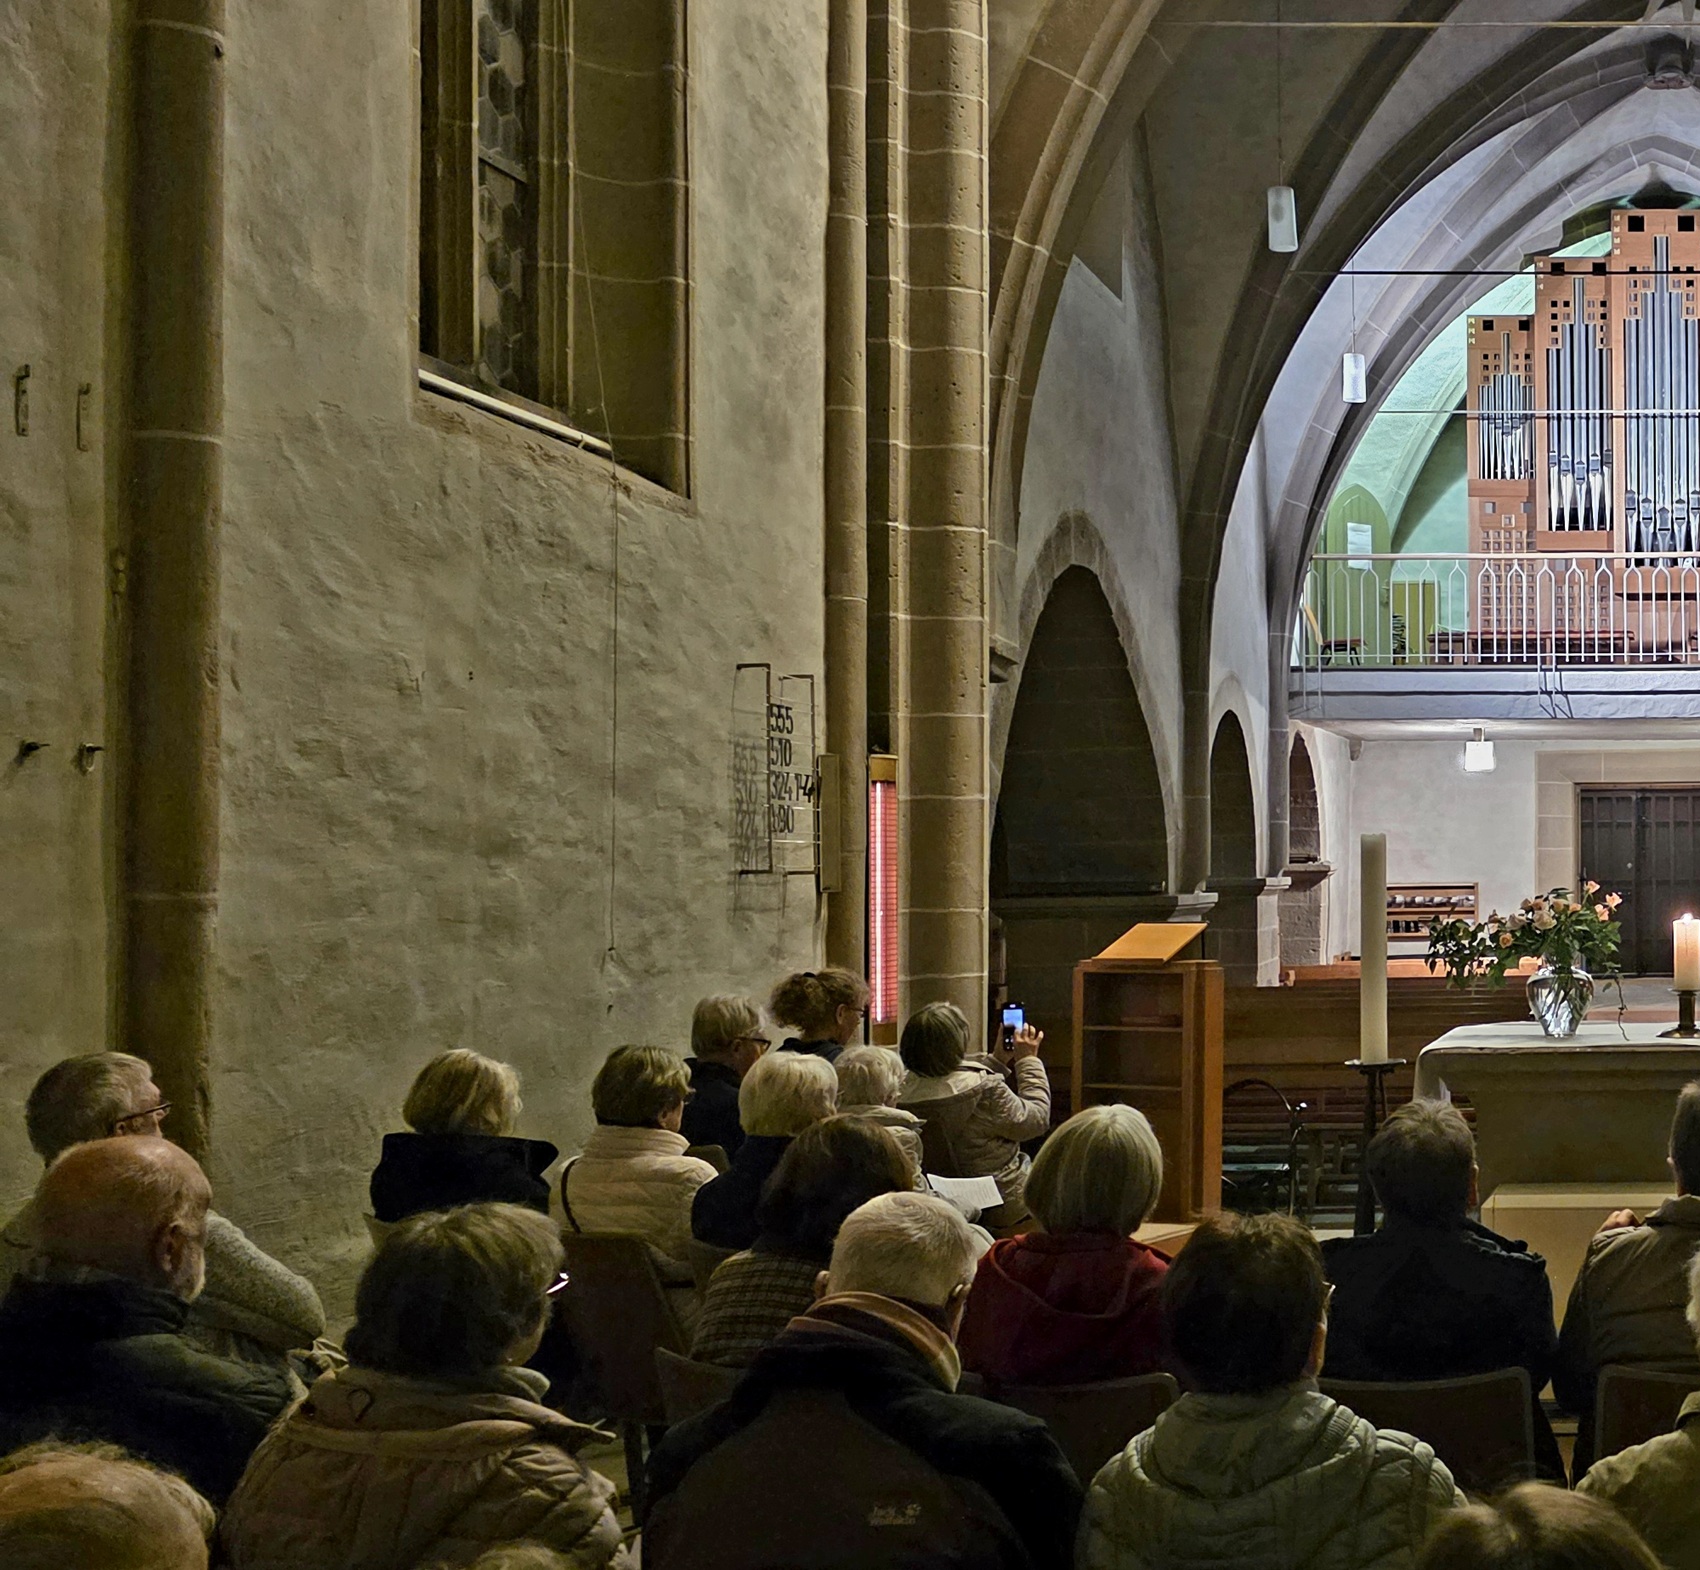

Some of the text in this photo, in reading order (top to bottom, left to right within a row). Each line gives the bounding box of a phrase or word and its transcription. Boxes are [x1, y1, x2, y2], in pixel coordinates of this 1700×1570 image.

[770, 703, 794, 735] 555
[770, 737, 792, 767] 510
[770, 771, 793, 801] 324
